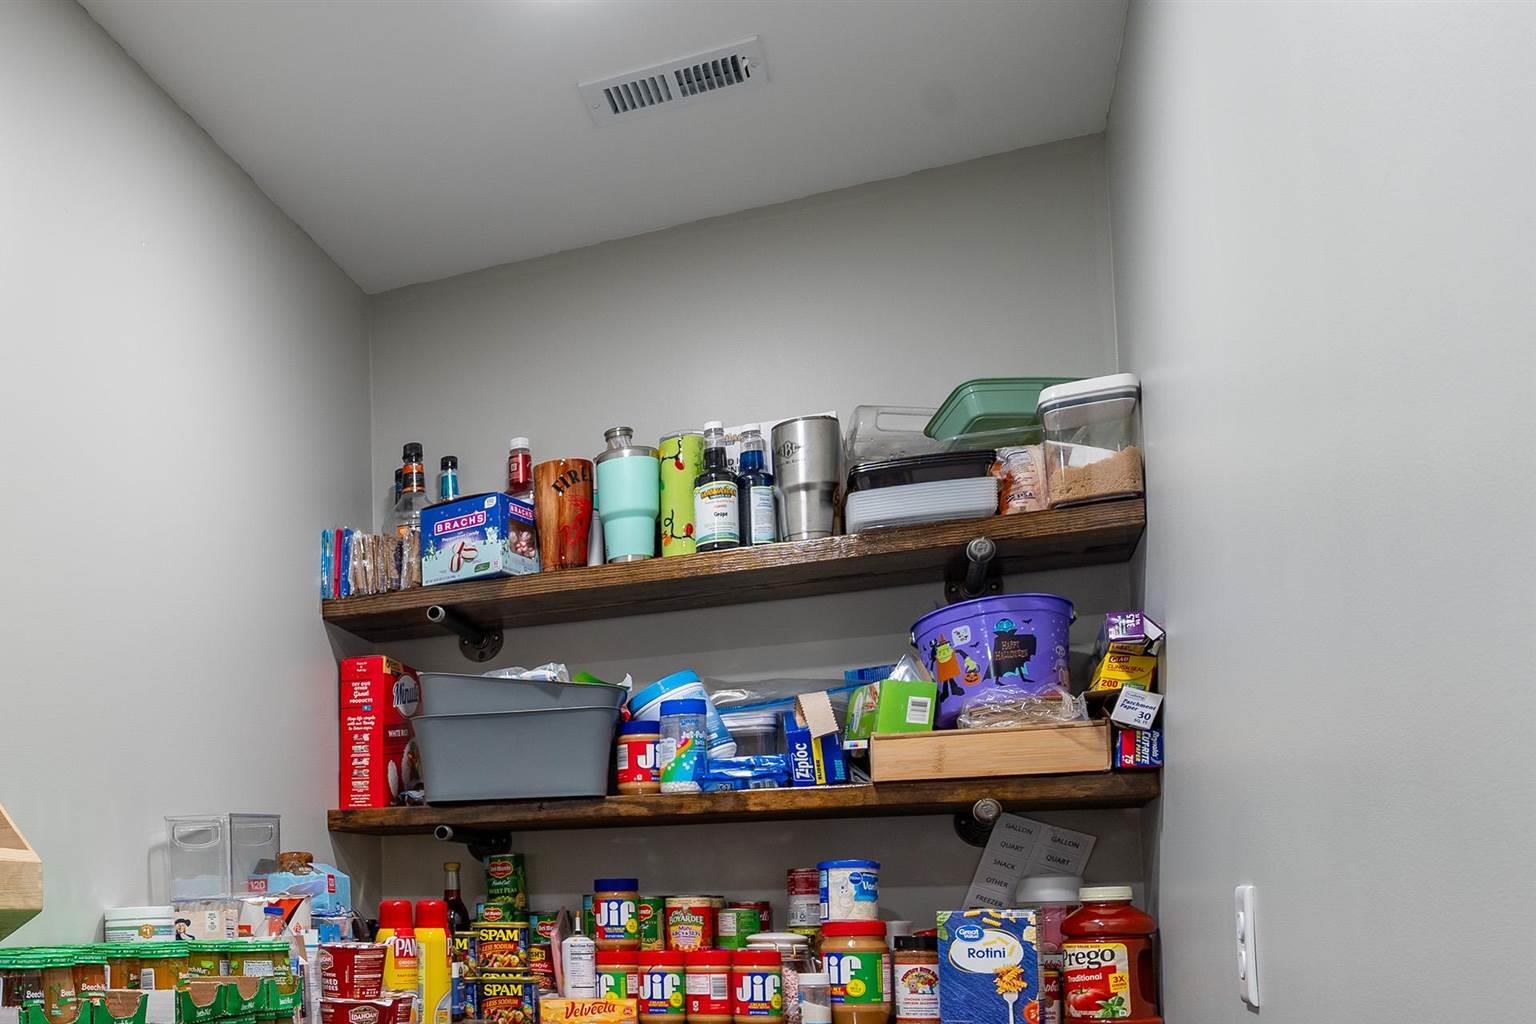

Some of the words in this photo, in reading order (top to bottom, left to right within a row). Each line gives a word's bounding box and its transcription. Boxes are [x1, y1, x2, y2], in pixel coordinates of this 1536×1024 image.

[510, 504, 533, 519] BRACHS
[436, 515, 485, 533] BRACHS
[1101, 679, 1119, 688] 200
[1120, 703, 1139, 712] Paper
[1122, 698, 1157, 711] Parchment
[1137, 711, 1152, 721] 30
[795, 742, 814, 779] Ziploc
[1123, 755, 1134, 765] 75
[1005, 822, 1033, 836] GALLON
[1000, 840, 1024, 853] QUART
[1051, 835, 1080, 850] GALLON
[993, 859, 1017, 871] SNACK
[1046, 854, 1071, 866] QUART
[249, 880, 267, 891] 120
[985, 876, 1009, 889] OTHER
[975, 894, 1004, 908] FREEZER
[596, 901, 636, 927] Jif
[479, 929, 519, 942] SPAM
[959, 928, 979, 936] Great
[482, 944, 495, 952] LESS
[495, 943, 514, 951] SODIUM
[967, 947, 1006, 959] Rotini
[1067, 972, 1103, 982] Traditional
[1112, 975, 1126, 983] 3X
[484, 984, 523, 996] SPAM
[639, 972, 681, 1000] Jif
[736, 974, 781, 1002] Jif
[498, 998, 519, 1006] SODIUM
[351, 1012, 378, 1021] IDAHOAN
[564, 1001, 616, 1020] Velveeta
